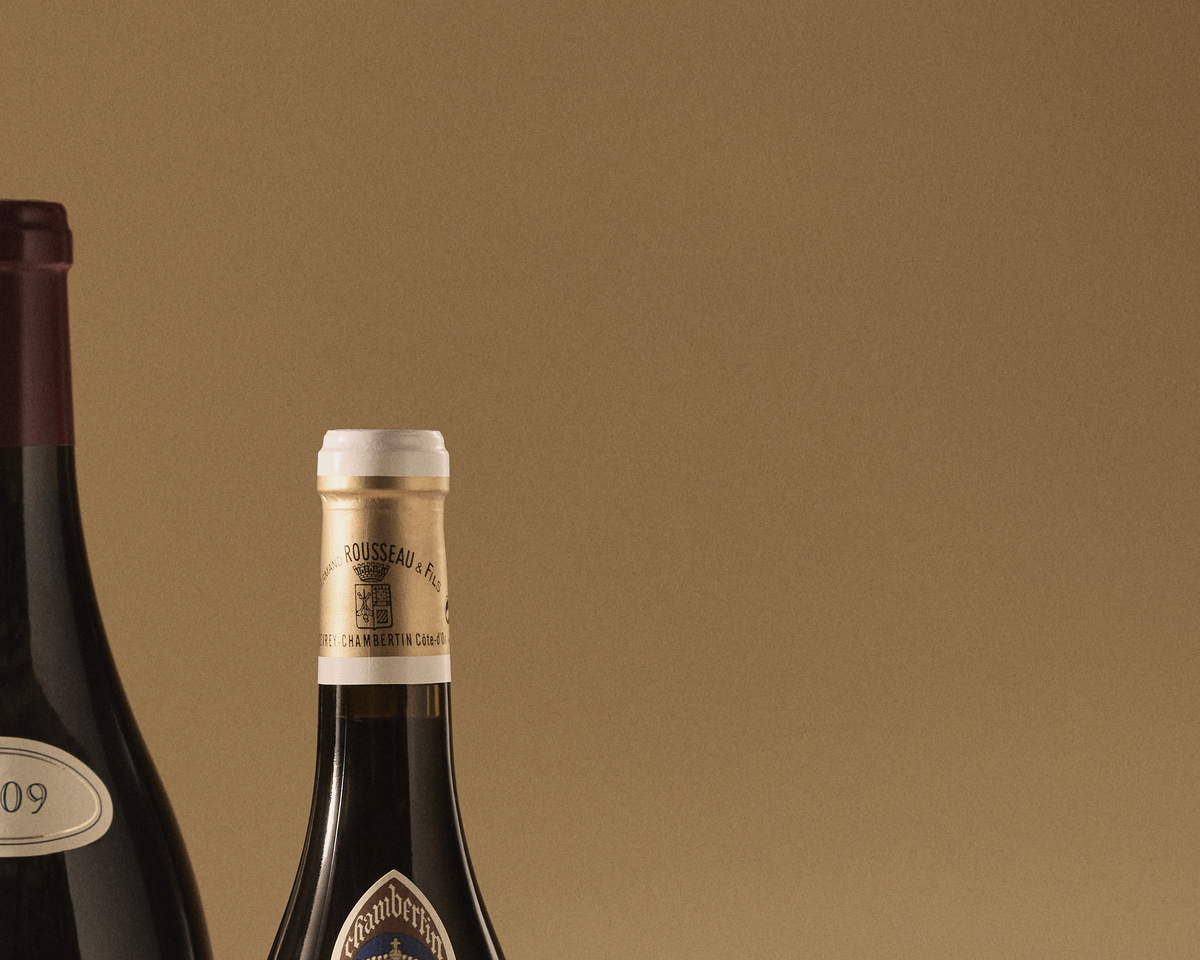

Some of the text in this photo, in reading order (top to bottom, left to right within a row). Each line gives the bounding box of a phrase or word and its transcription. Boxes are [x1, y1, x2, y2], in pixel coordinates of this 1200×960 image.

[344, 542, 415, 569] ROUSSEAU
[415, 562, 422, 574] &
[319, 633, 412, 647] EVREY-CHAMBERTIN
